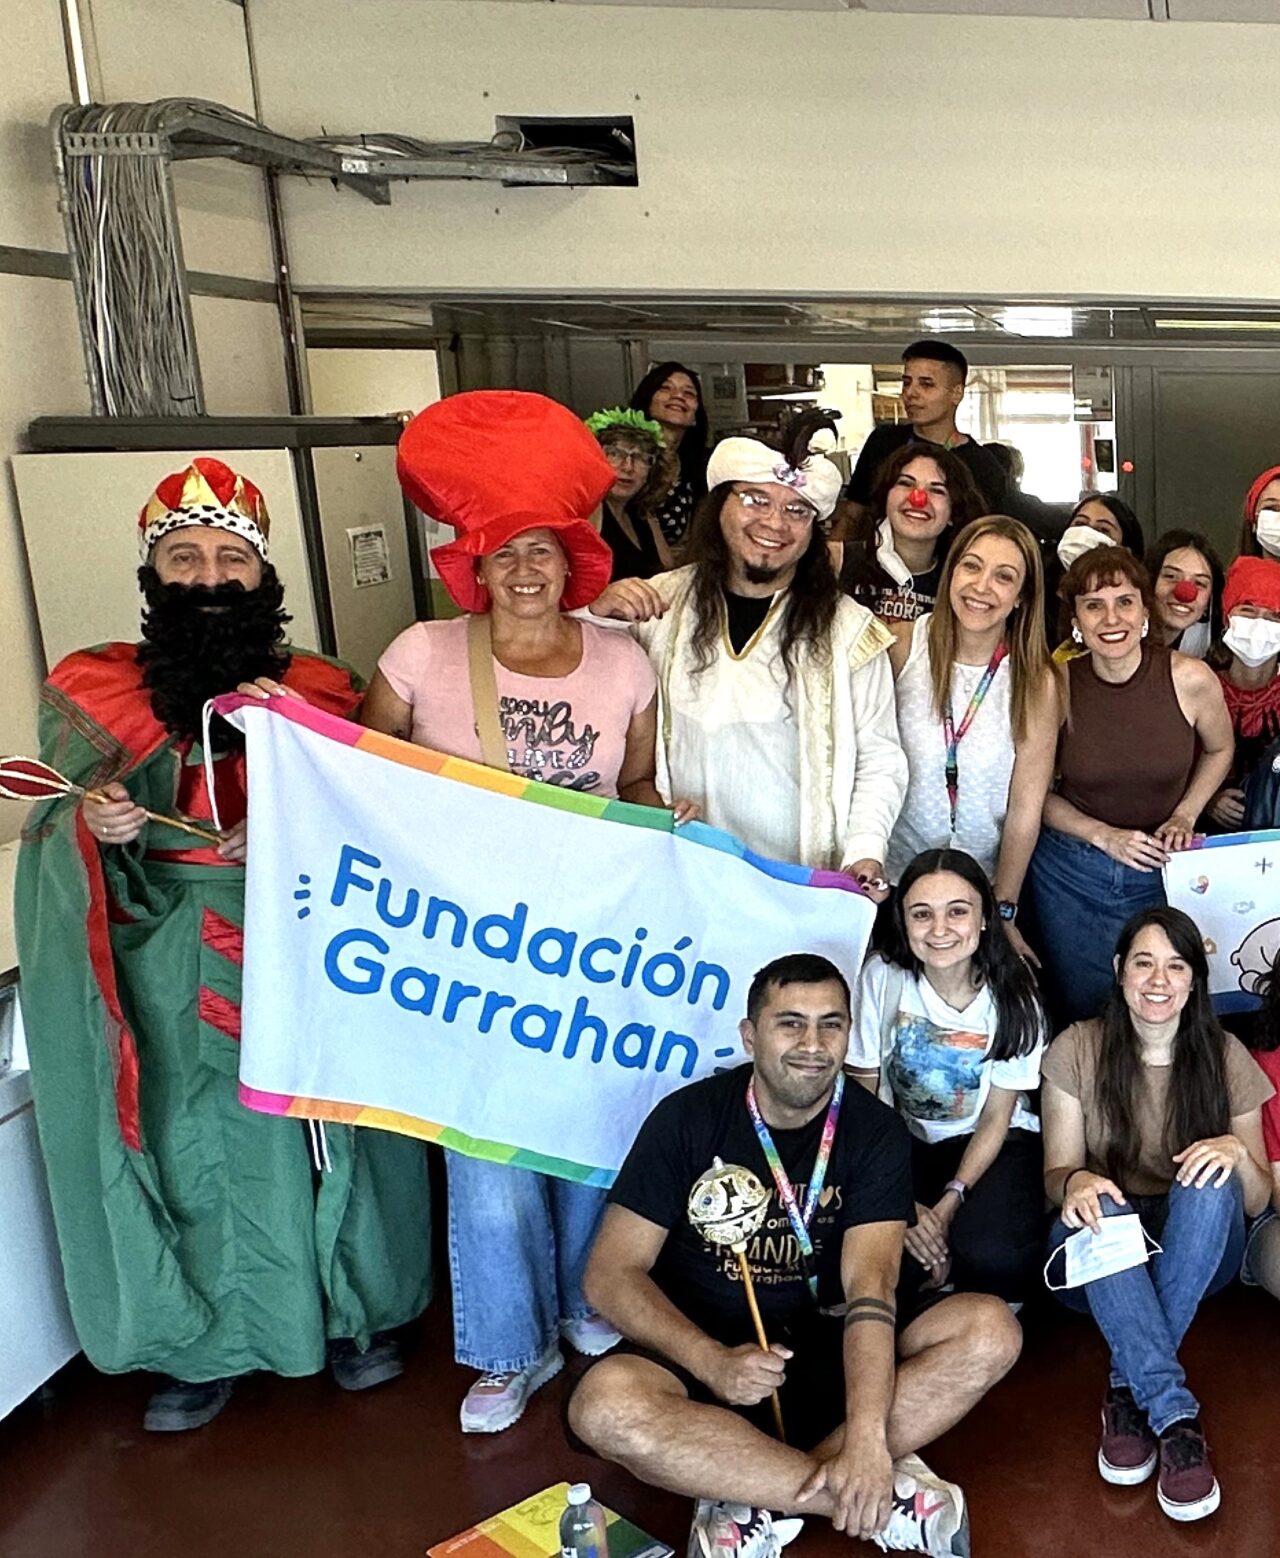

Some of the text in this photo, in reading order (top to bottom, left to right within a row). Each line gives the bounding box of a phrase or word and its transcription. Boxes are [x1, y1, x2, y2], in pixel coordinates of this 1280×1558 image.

[498, 701, 601, 770] nly
[331, 845, 731, 1010] Fundación
[325, 929, 699, 1078] Garrahan
